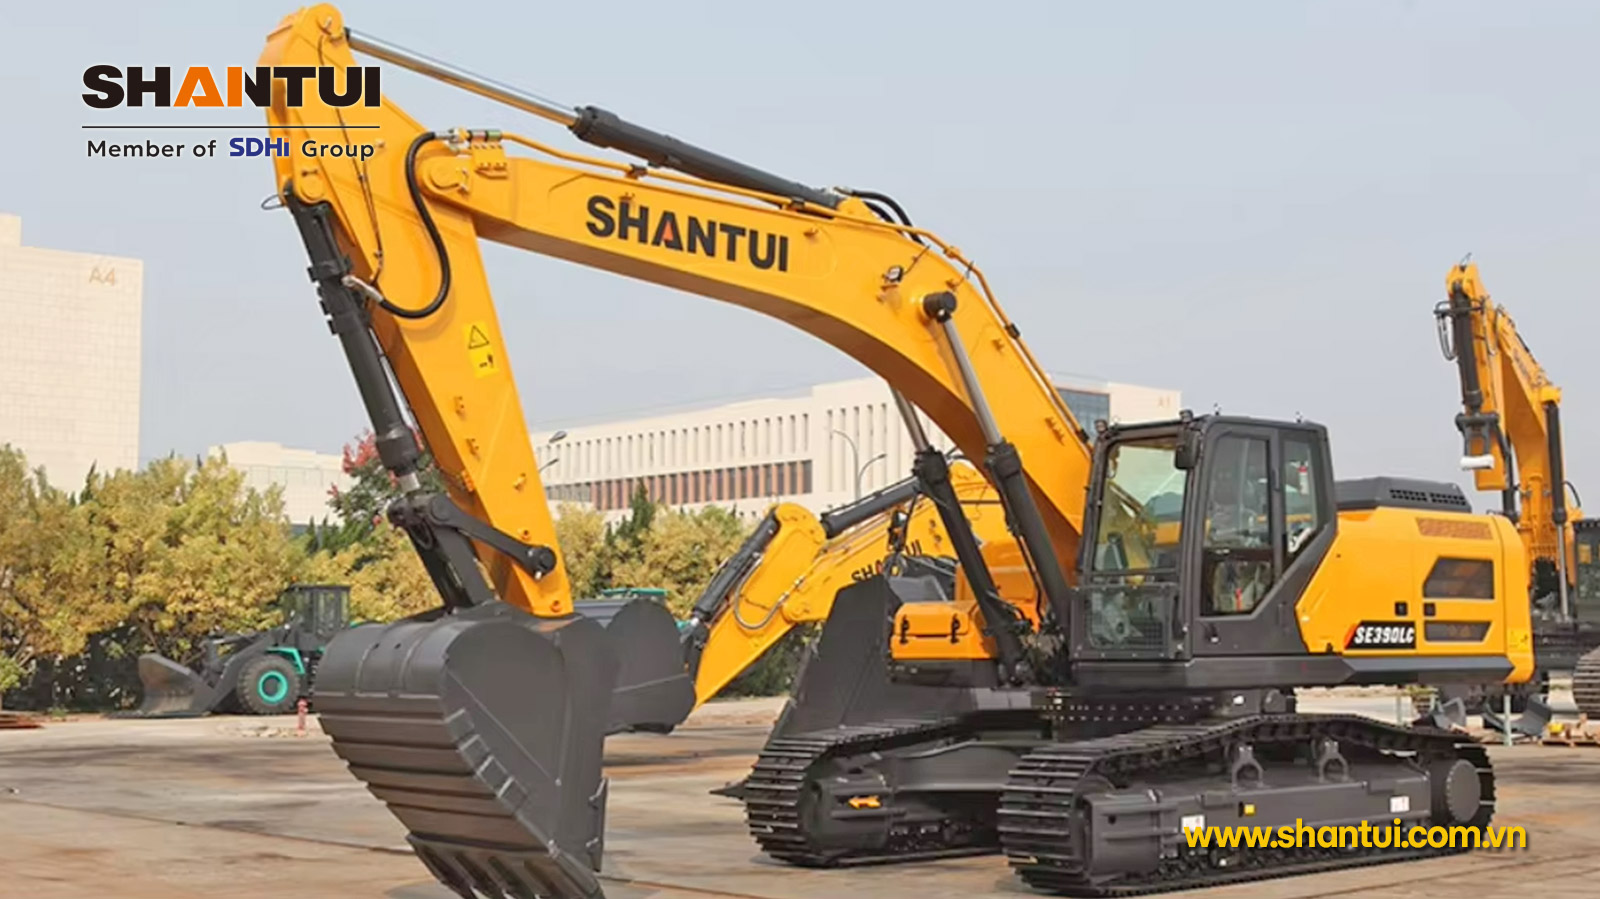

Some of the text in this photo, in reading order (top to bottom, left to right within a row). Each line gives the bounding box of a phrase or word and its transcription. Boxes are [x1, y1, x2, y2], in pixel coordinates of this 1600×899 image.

[586, 195, 789, 272] SHANTUI
[89, 266, 116, 286] A4
[1354, 626, 1415, 645] SE390LC
